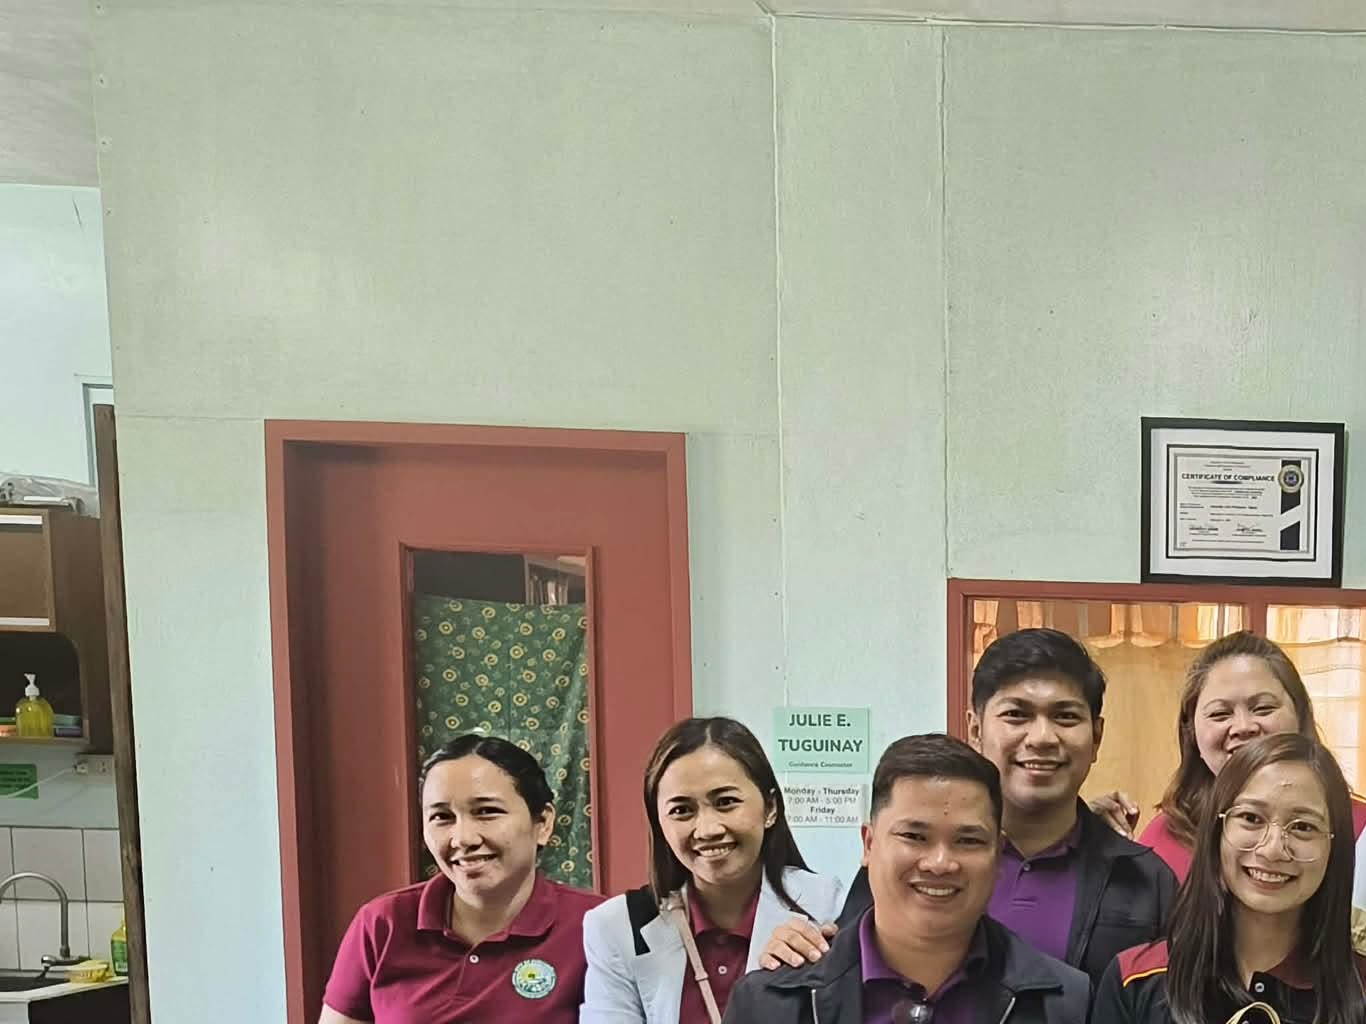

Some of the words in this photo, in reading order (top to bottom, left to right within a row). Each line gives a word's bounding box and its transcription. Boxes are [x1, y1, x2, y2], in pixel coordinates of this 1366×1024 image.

[1181, 472, 1222, 481] CERTIFICATE
[1233, 474, 1275, 482] COMPLIANCE
[788, 713, 832, 727] JULIE
[836, 713, 851, 727] E.
[777, 738, 863, 752] TUGUINAY
[783, 787, 816, 796] Monday
[823, 787, 860, 796] Thursday
[810, 806, 835, 814] Friday
